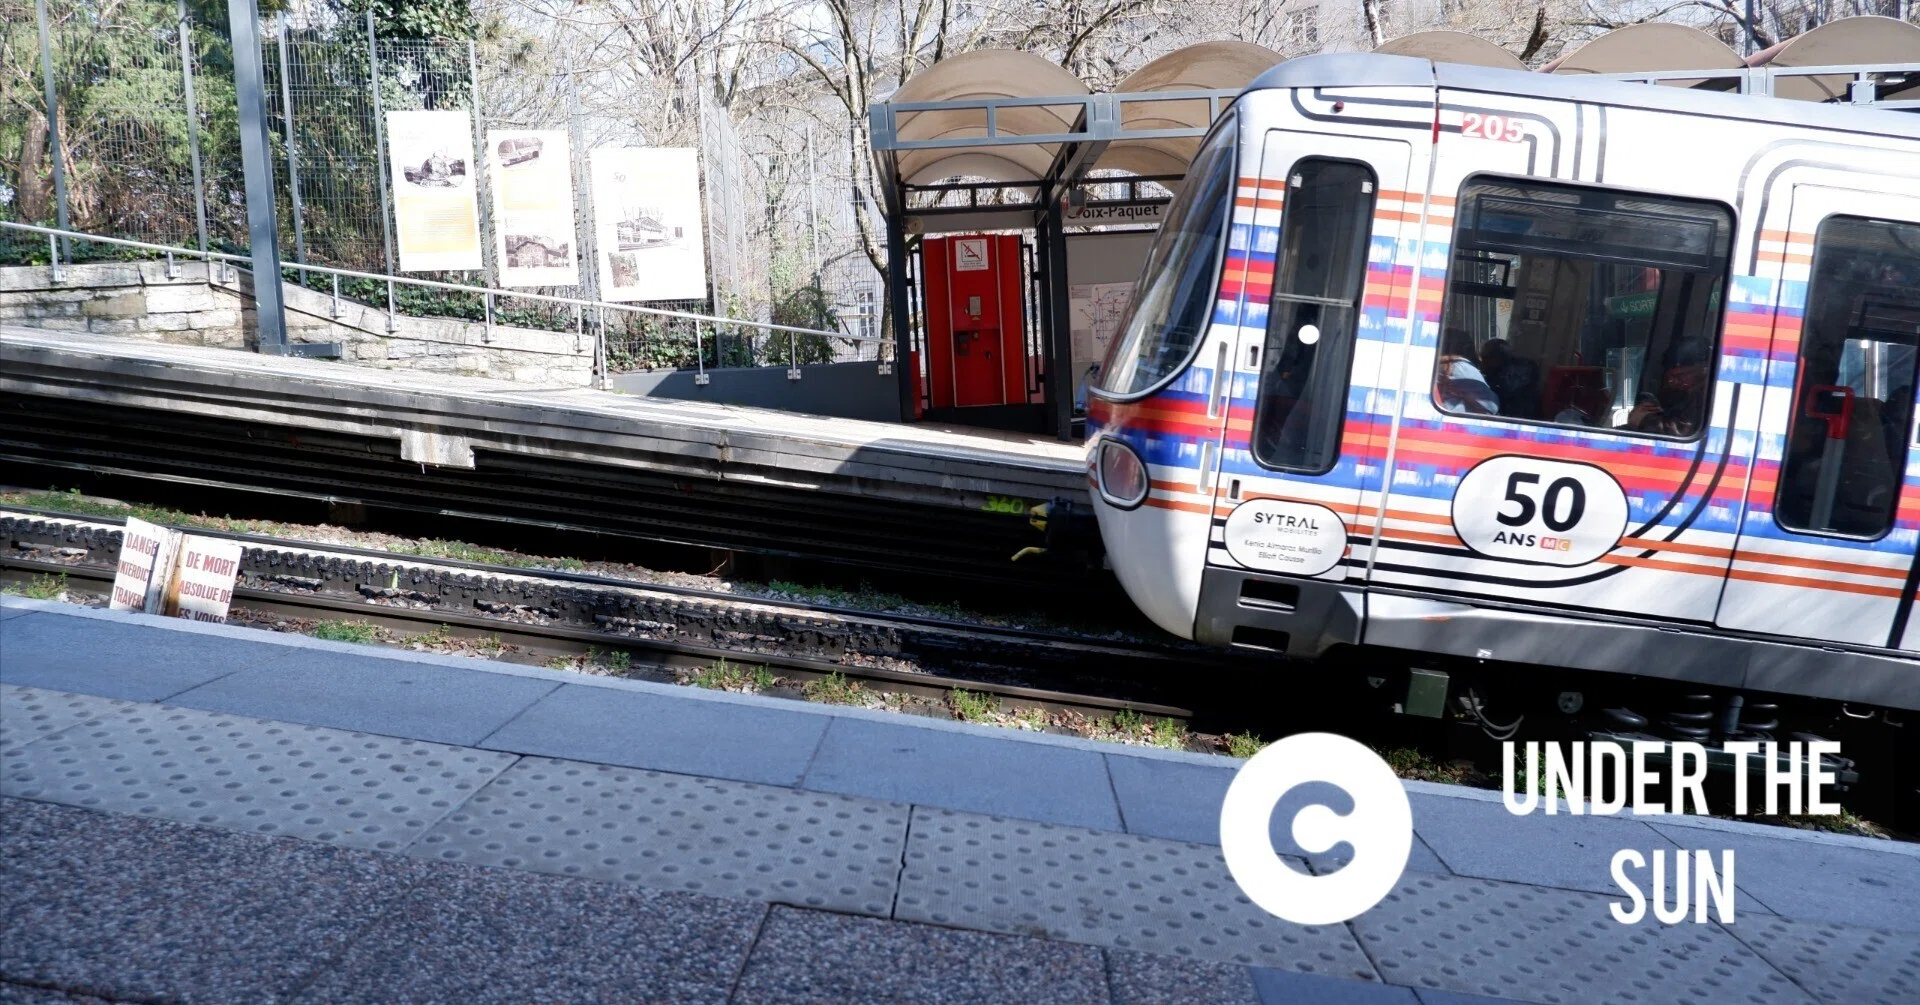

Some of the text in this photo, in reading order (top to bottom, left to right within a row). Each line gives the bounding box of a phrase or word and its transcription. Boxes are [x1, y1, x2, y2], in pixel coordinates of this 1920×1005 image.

[1462, 113, 1524, 142] 205
[1068, 205, 1159, 220] oix-Paquet
[1496, 471, 1586, 532] 50
[1254, 512, 1319, 530] SYTRAL
[1493, 531, 1536, 547] ANS
[185, 551, 201, 569] DE
[202, 555, 236, 577] MORT
[177, 580, 219, 602] ABSOLUE
[219, 590, 232, 604] DE
